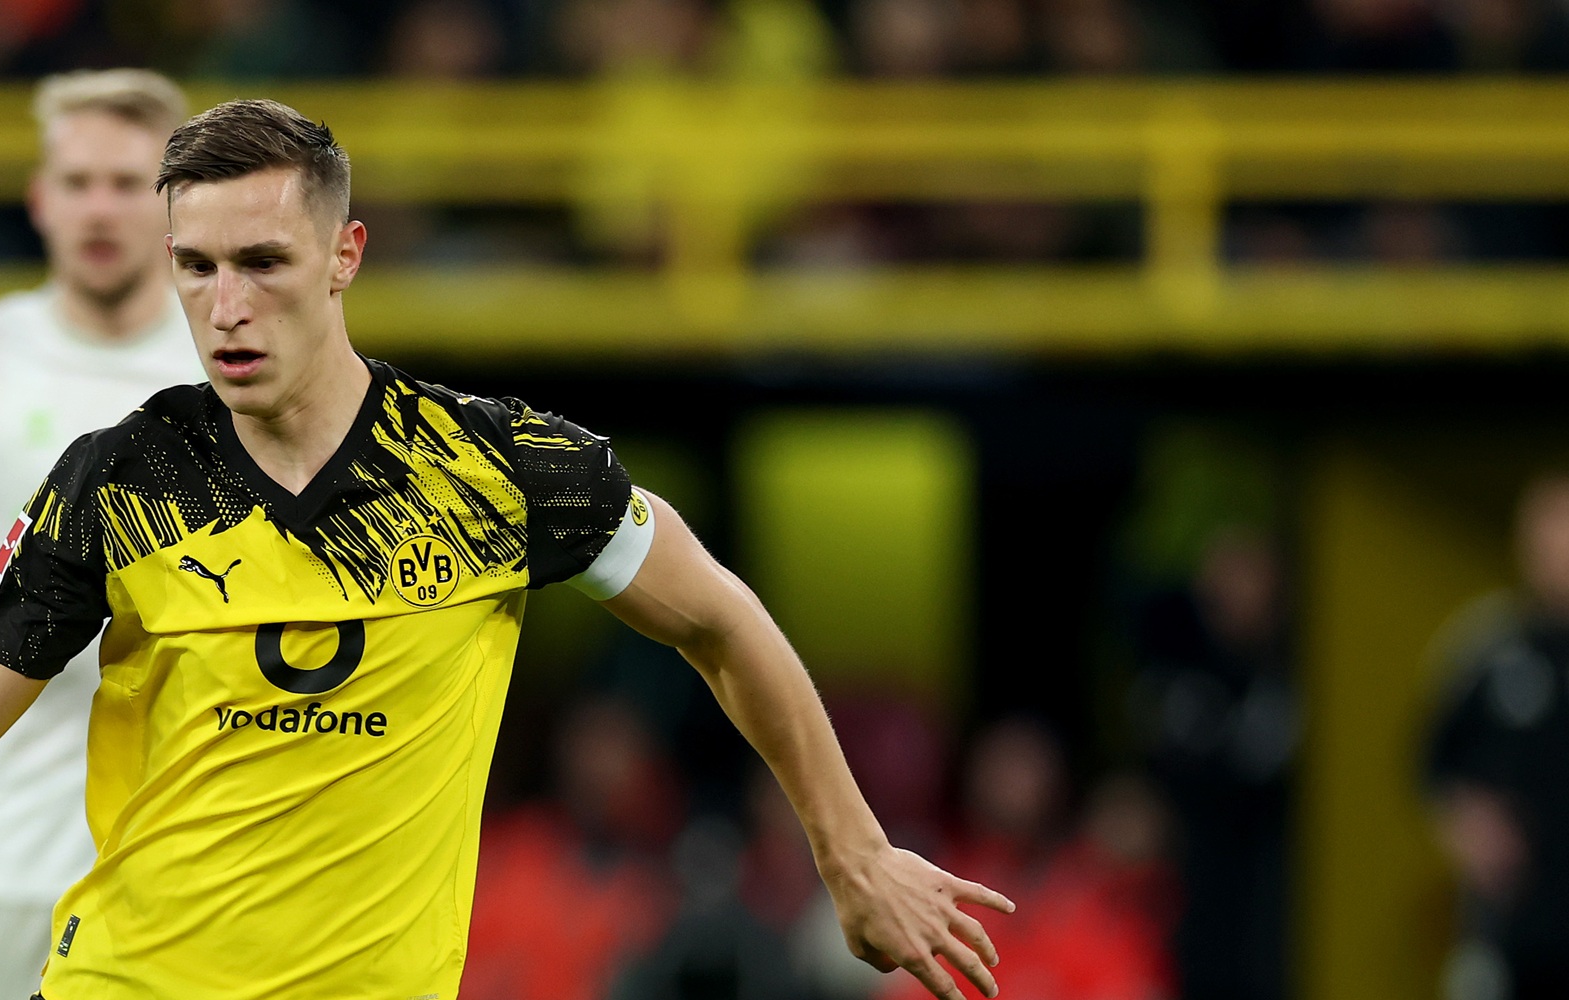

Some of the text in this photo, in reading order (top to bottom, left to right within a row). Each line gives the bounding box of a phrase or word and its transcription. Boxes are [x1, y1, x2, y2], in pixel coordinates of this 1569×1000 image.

[398, 541, 453, 588] BVB
[417, 584, 437, 600] 09
[214, 702, 387, 737] vodafone
